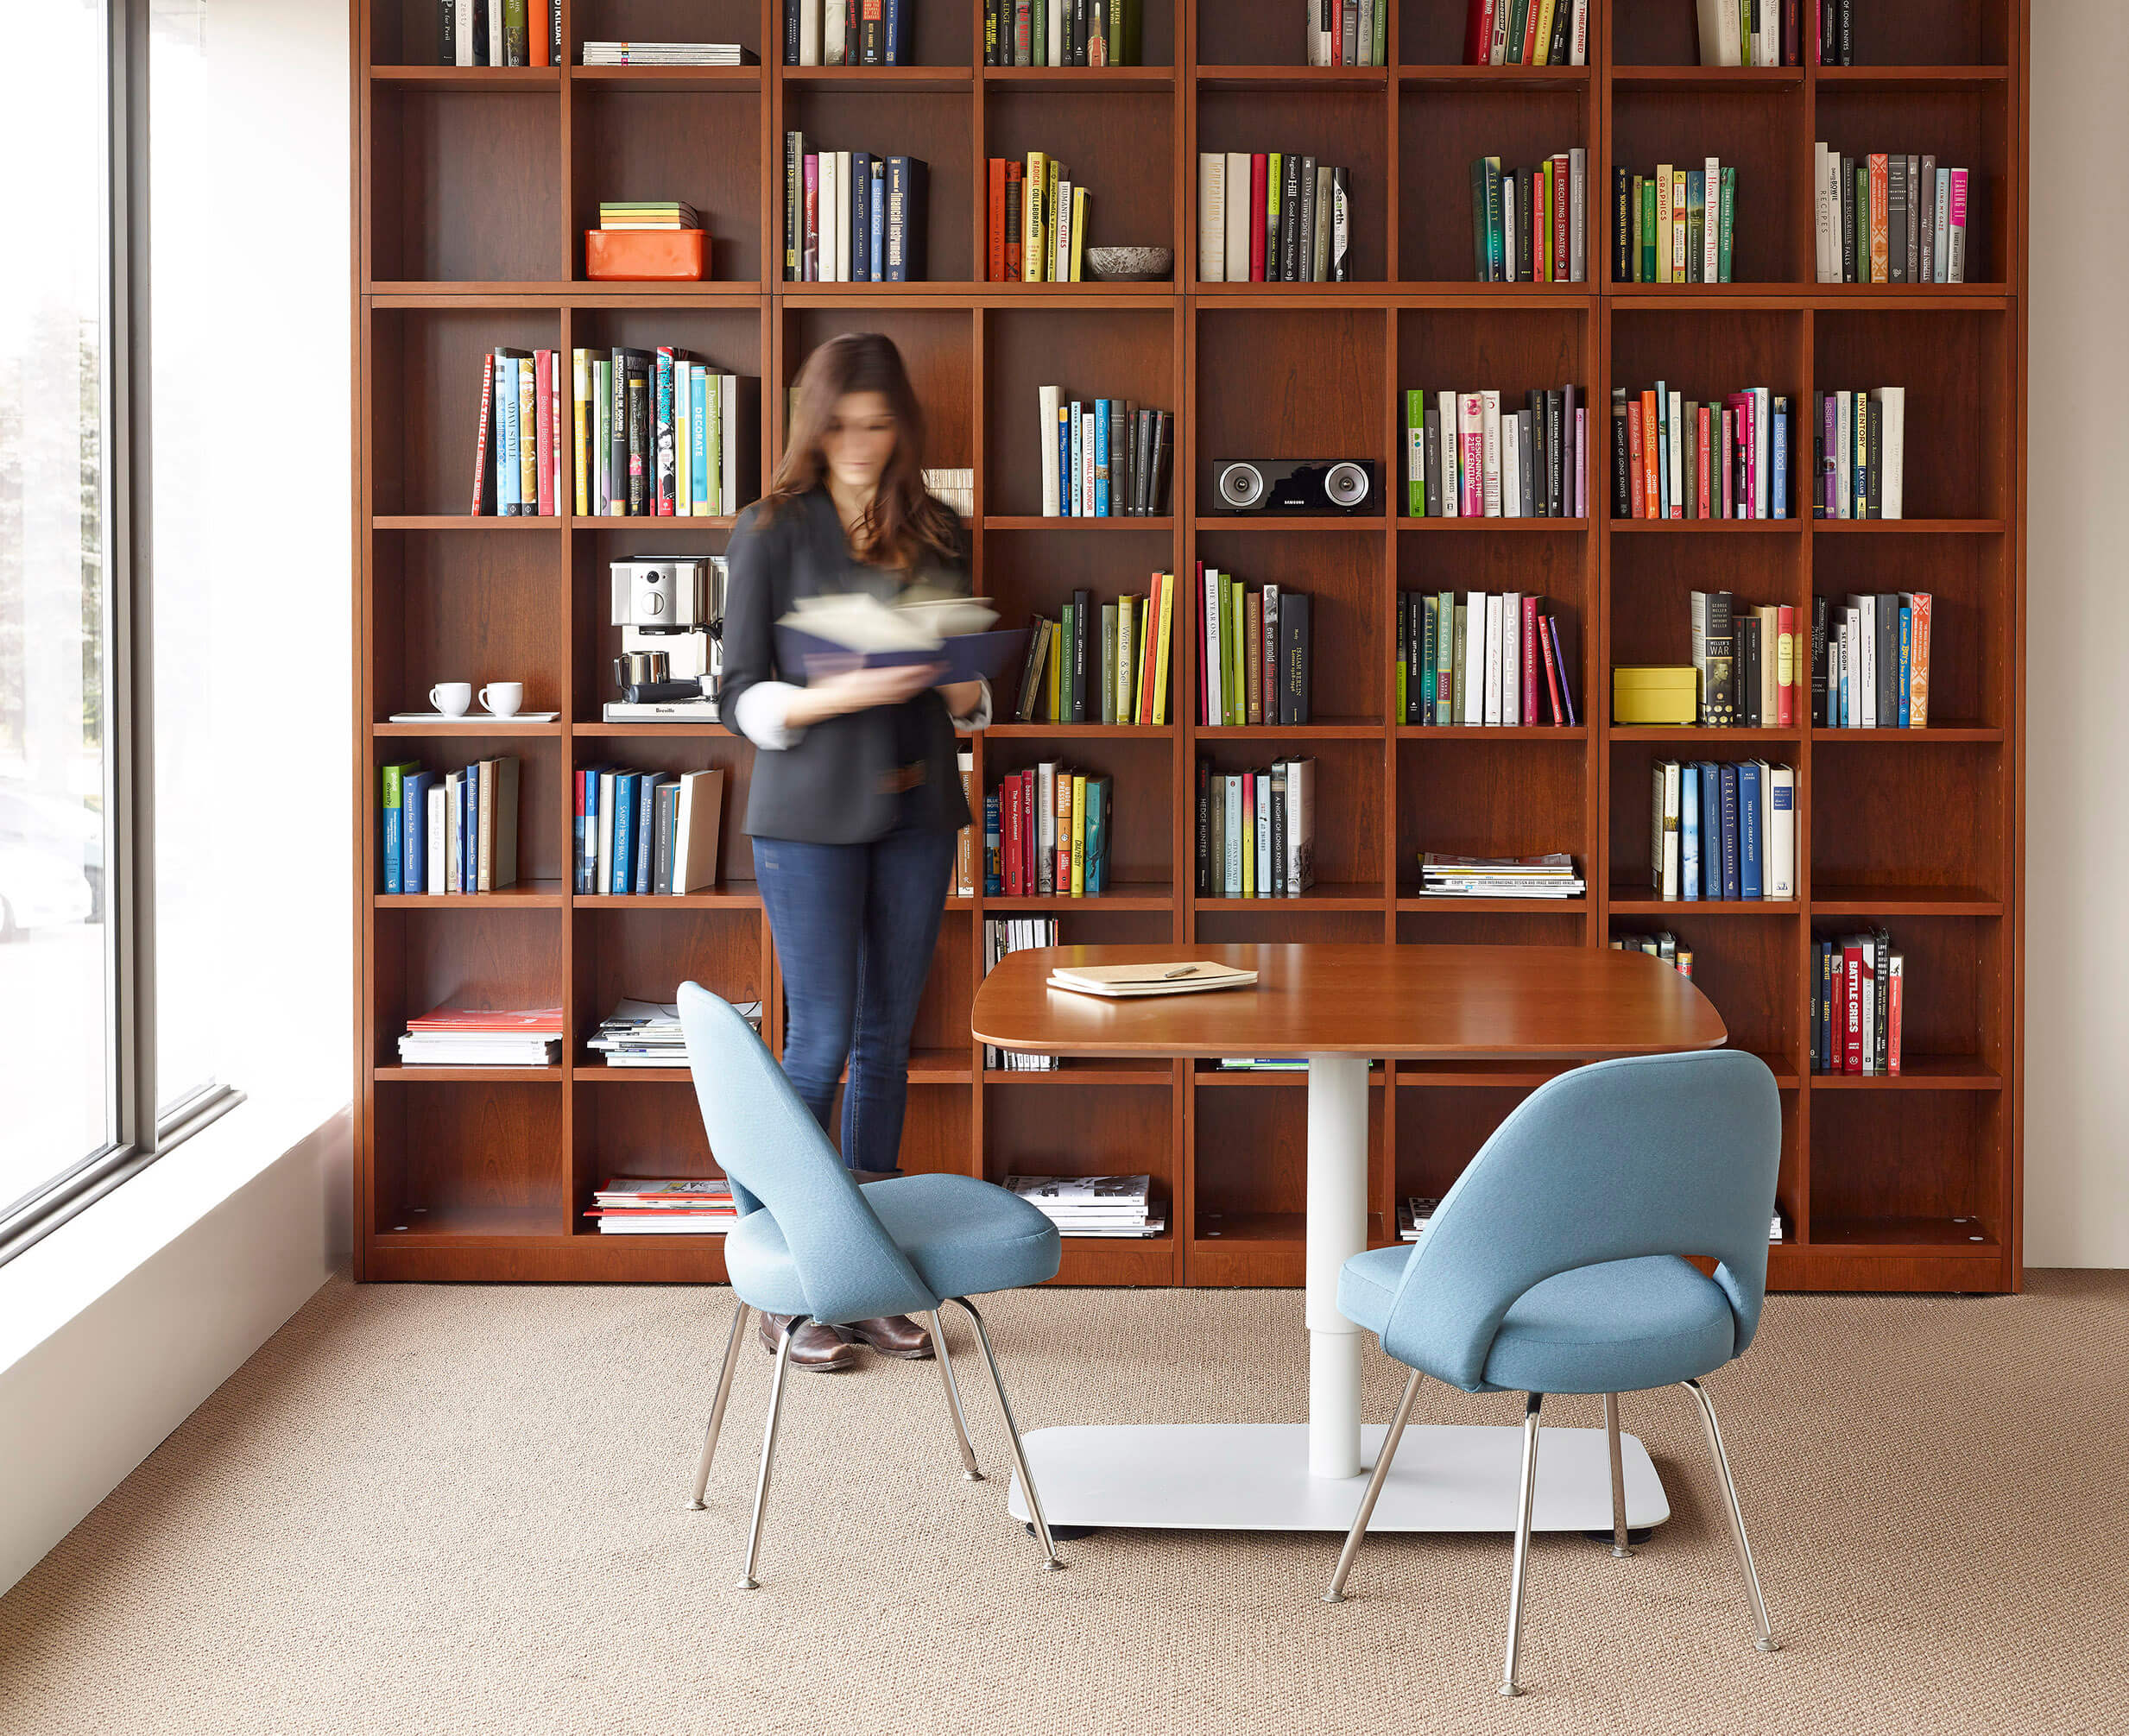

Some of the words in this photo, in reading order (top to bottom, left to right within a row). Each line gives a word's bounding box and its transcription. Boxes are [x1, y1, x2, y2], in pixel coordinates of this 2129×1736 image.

[1288, 180, 1297, 196] Hill
[1490, 173, 1498, 221] VERACITY
[1658, 176, 1667, 221] GRAPHICS
[1708, 177, 1717, 198] How
[891, 193, 903, 223] financial
[1707, 201, 1716, 237] Doctors
[1820, 190, 1828, 233] RECIPES
[873, 214, 881, 235] food
[890, 224, 903, 265] instruments
[1706, 240, 1716, 269] Think
[1825, 402, 1834, 428] asian
[1646, 416, 1655, 451] SPARK
[1776, 422, 1785, 448] street
[1777, 450, 1785, 470] food
[1087, 477, 1093, 485] OF
[1121, 626, 1130, 650] Write
[1710, 646, 1729, 655] WAR
[1121, 670, 1129, 686] Sell
[1266, 679, 1275, 702] journal
[1725, 775, 1734, 827] VERACITY
[1276, 823, 1281, 831] OF
[1848, 961, 1858, 1001] BATTLE
[1848, 1001, 1858, 1033] CRIES
